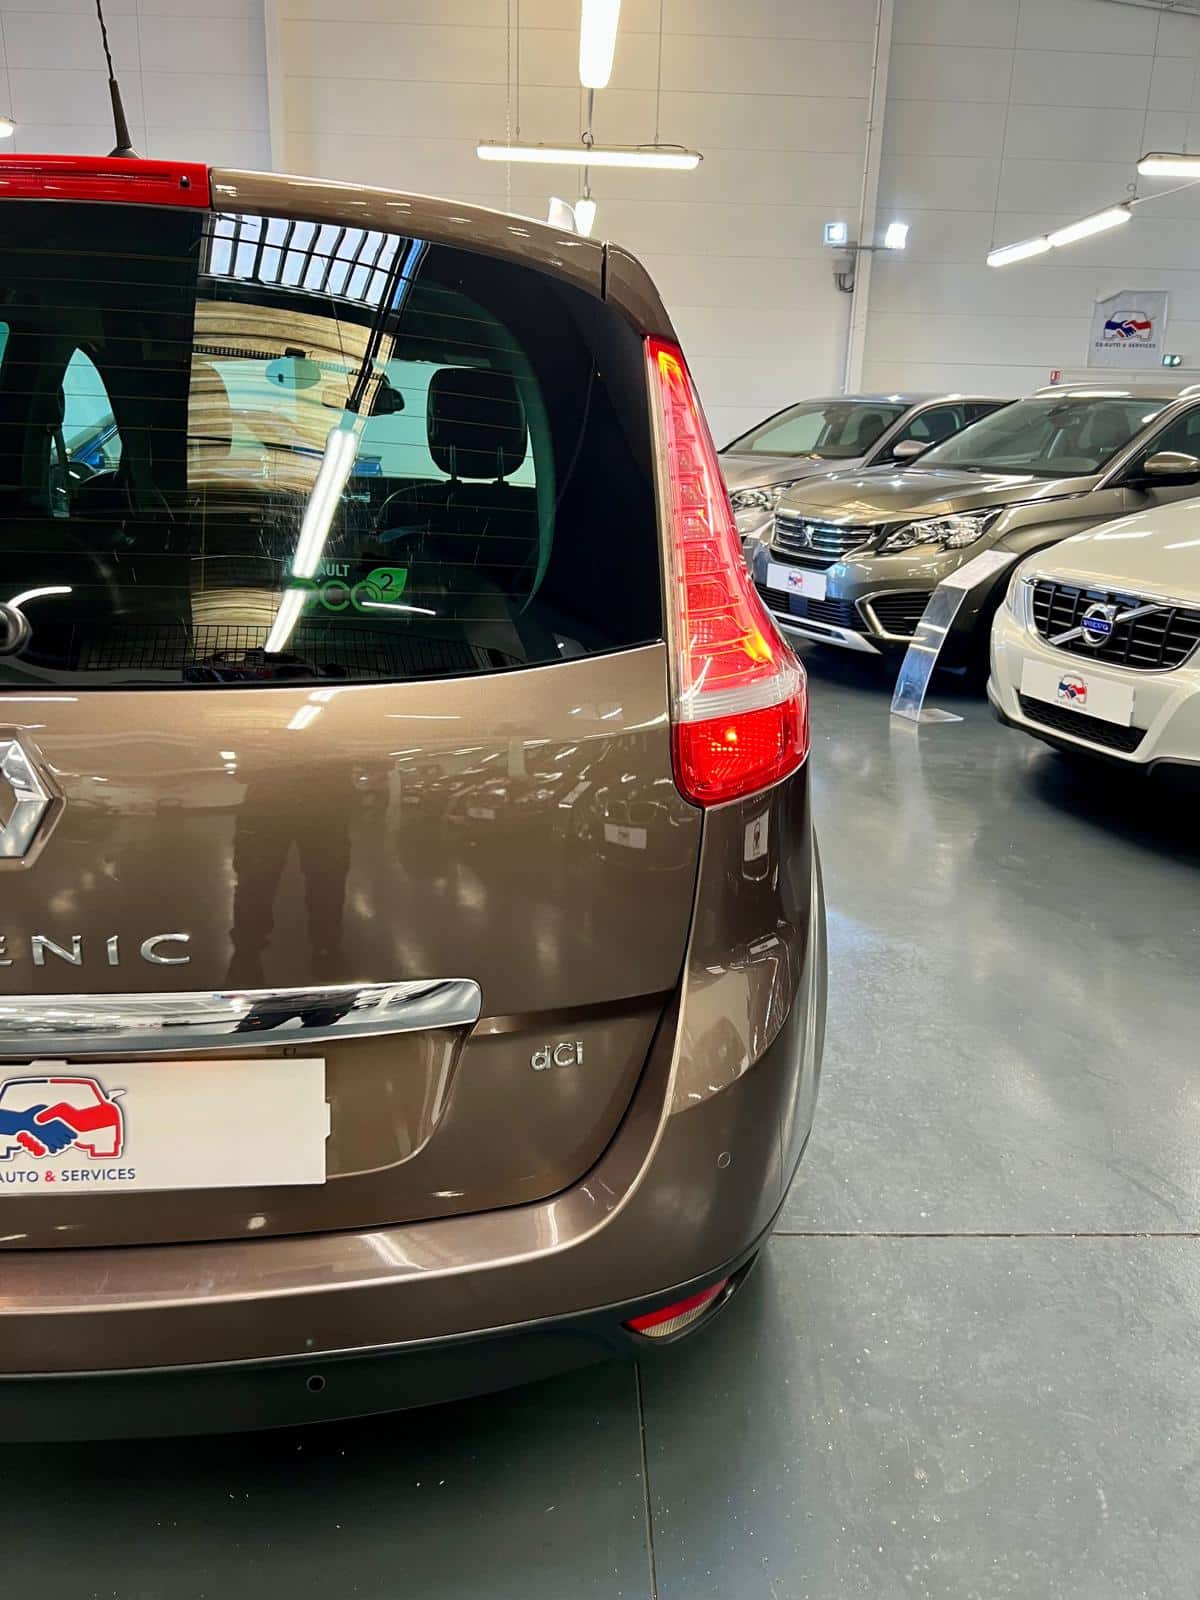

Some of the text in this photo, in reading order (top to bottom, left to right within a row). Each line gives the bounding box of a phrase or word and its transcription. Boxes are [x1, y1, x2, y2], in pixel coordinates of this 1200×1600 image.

[1083, 619, 1109, 631] VOLVO
[530, 1040, 584, 1071] dCi
[44, 1170, 56, 1183] &
[61, 1168, 136, 1182] SERVICES
